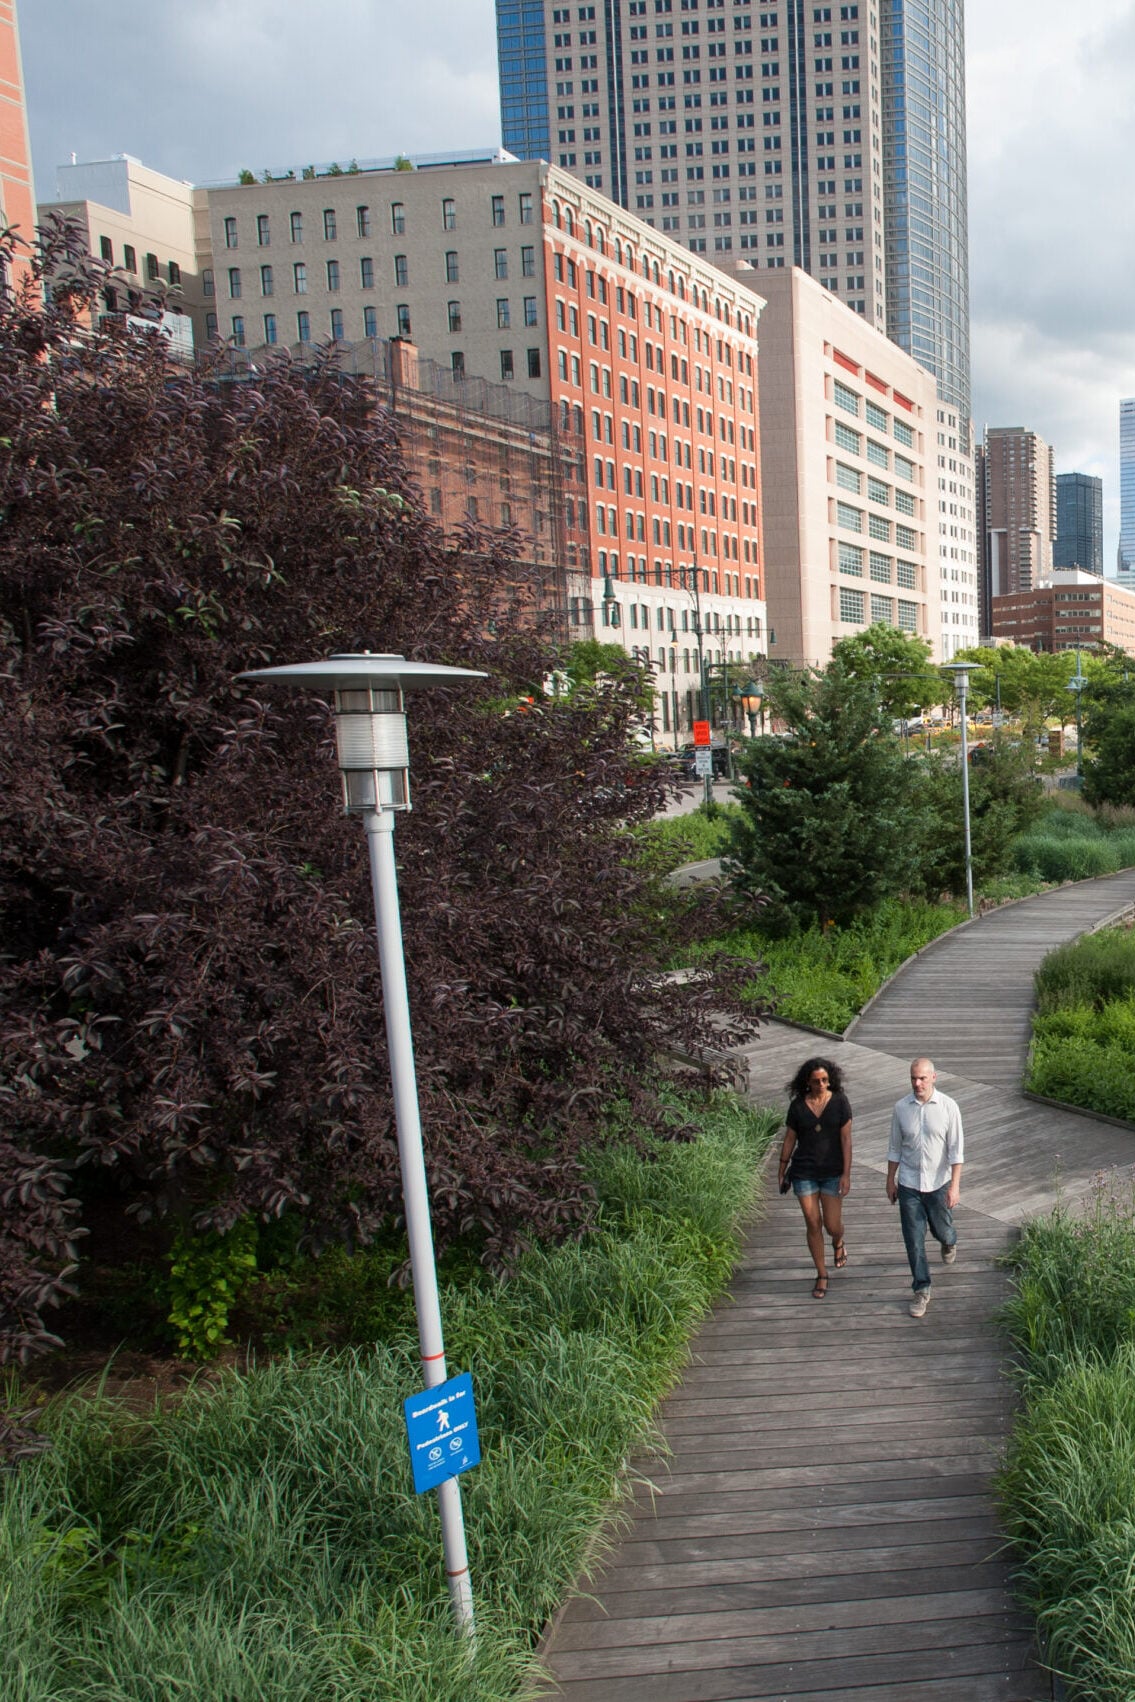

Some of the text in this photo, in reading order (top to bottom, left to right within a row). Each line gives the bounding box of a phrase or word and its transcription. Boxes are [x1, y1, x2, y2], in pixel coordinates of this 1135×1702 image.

[412, 1398, 448, 1418] Boardwalk
[455, 1390, 466, 1398] for
[416, 1421, 469, 1450] Pedestrians ONLY
